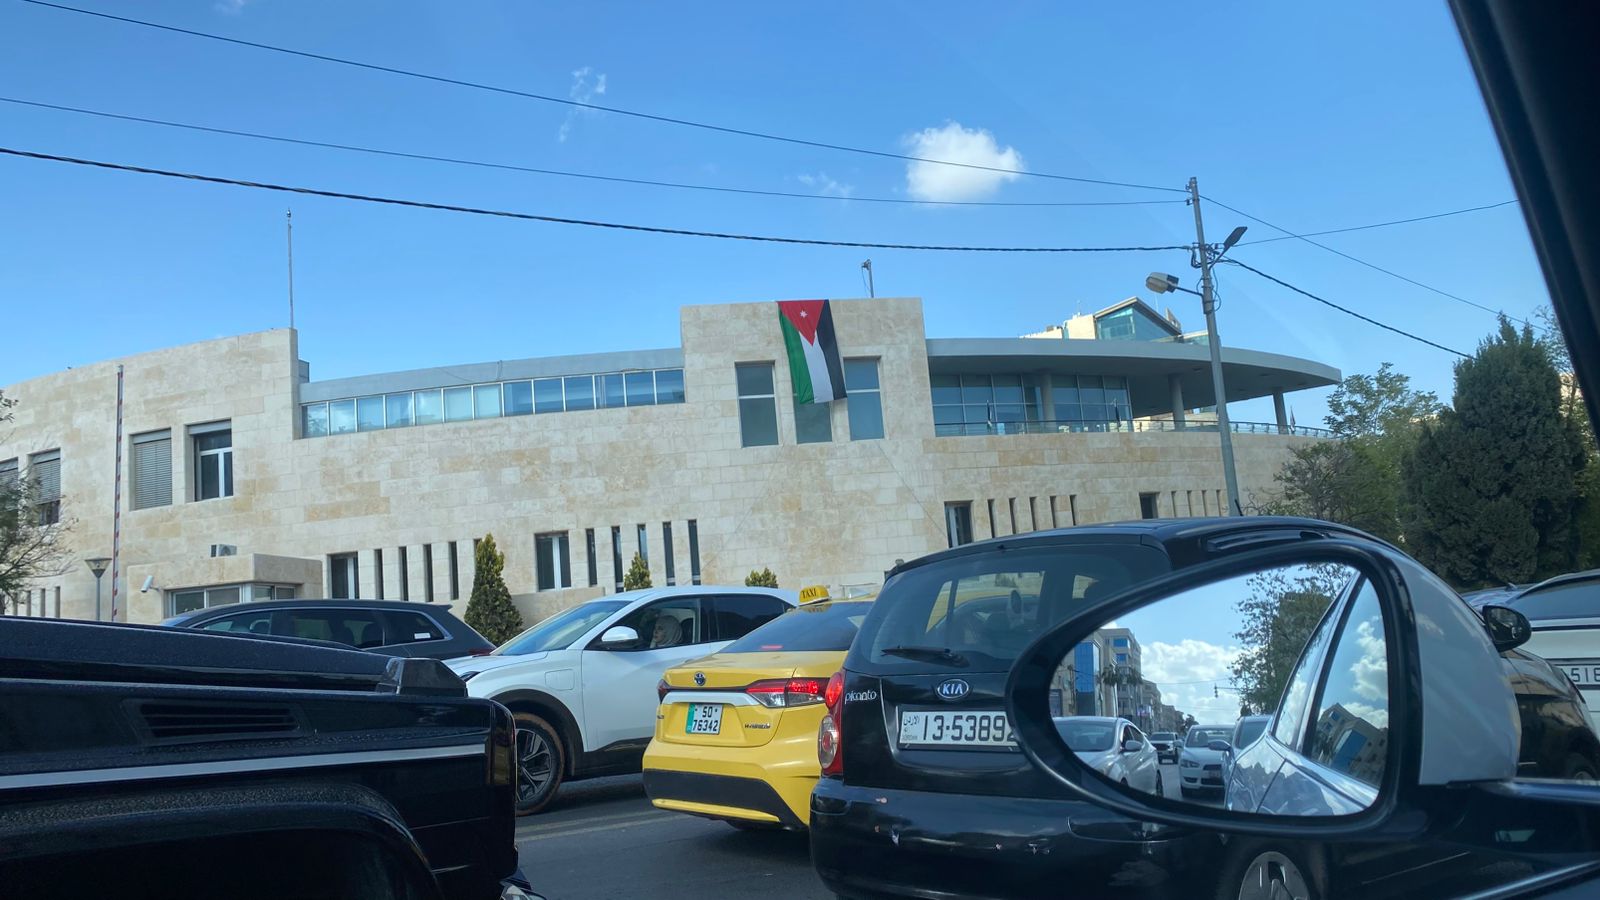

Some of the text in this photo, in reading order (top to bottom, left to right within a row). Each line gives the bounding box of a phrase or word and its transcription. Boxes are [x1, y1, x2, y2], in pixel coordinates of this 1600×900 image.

[800, 587, 817, 599] TAXI
[942, 683, 963, 695] KIA
[692, 719, 719, 732] 76342
